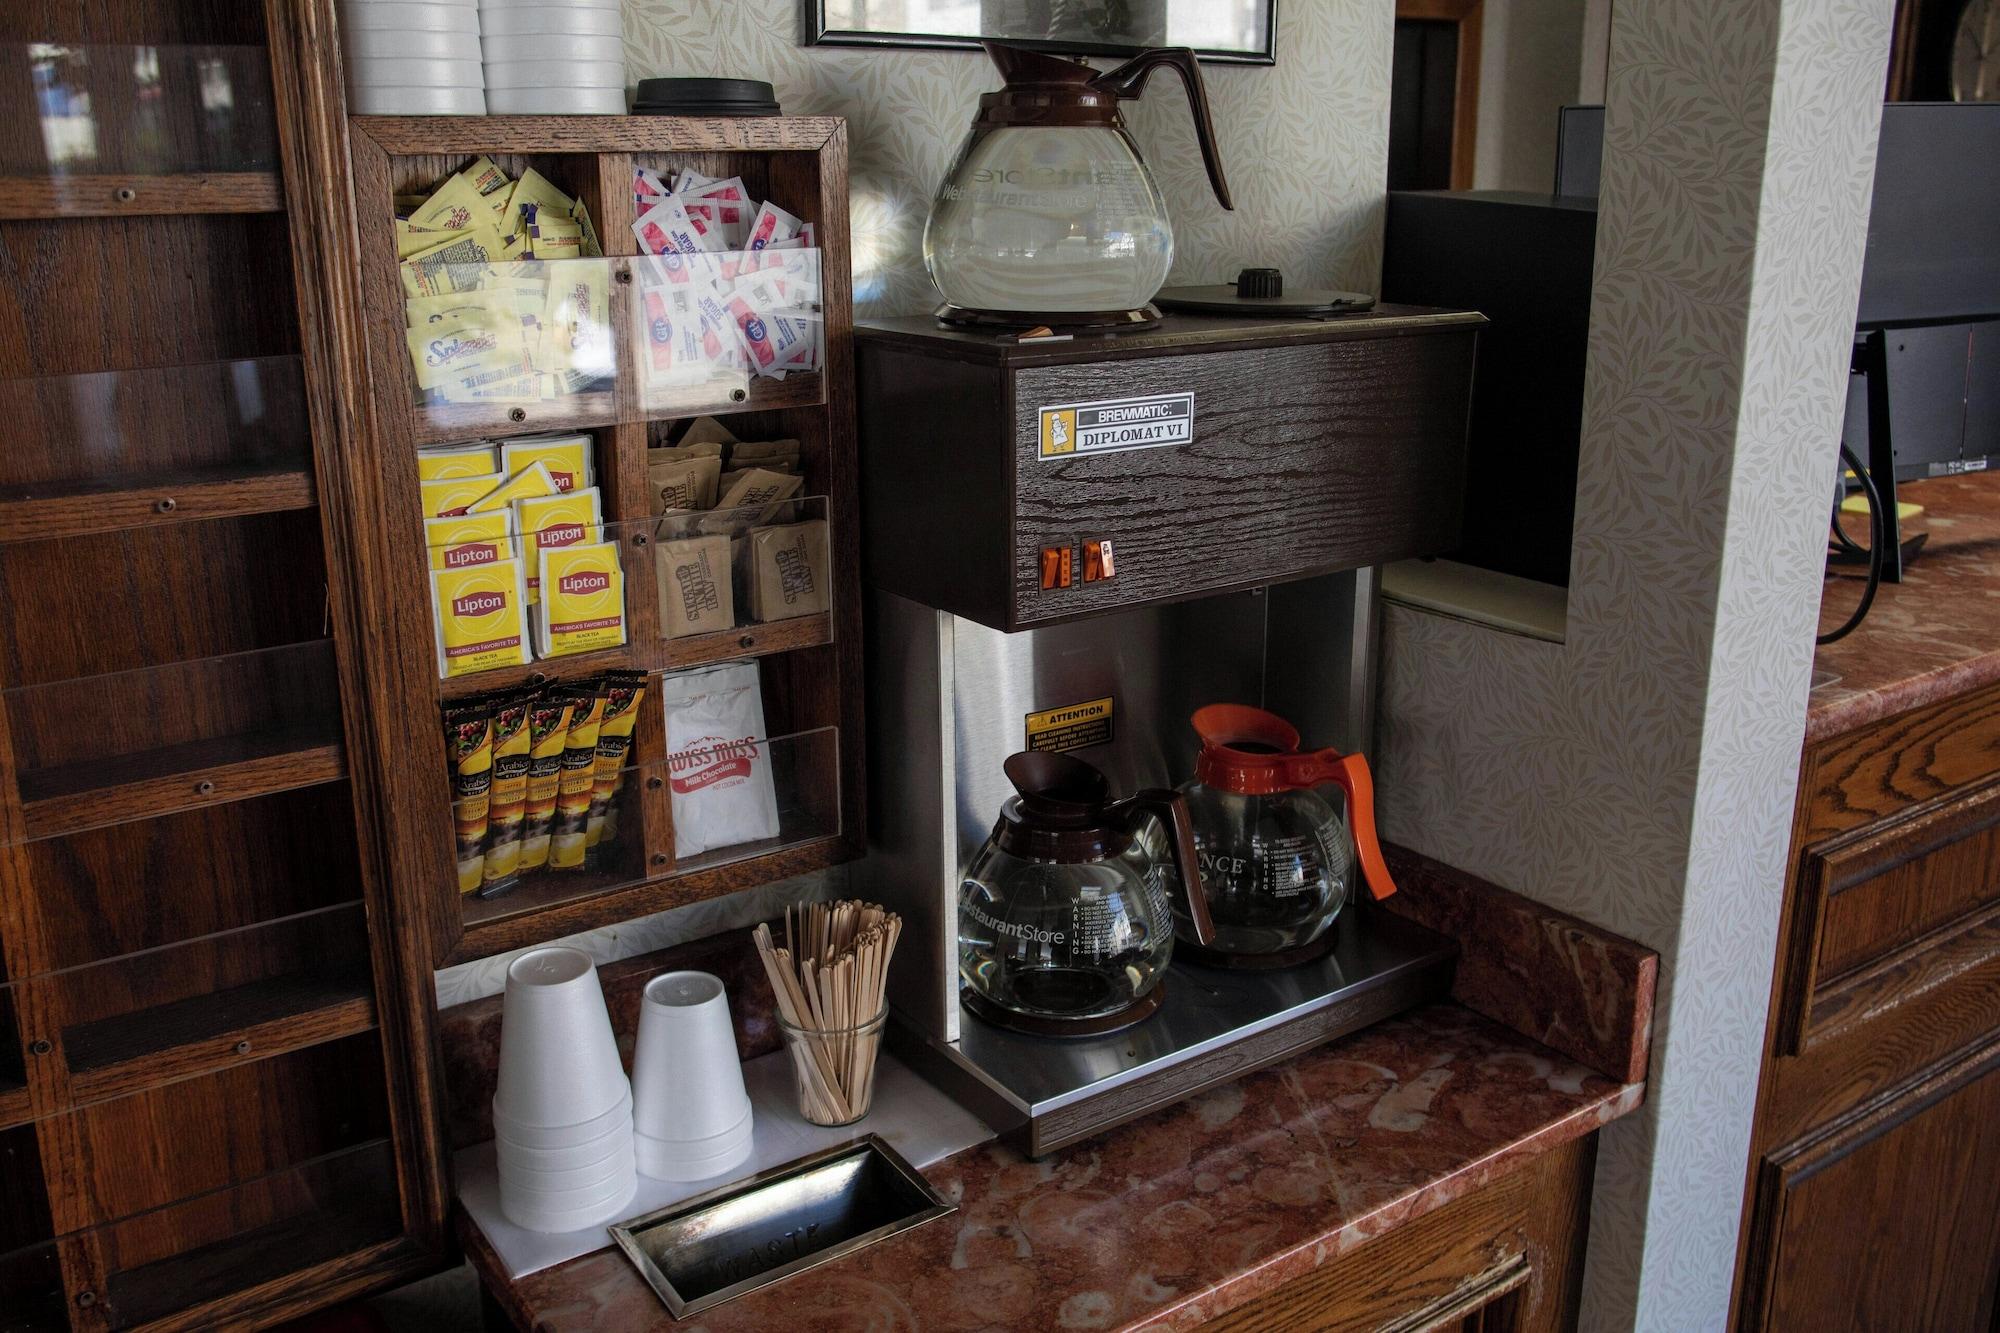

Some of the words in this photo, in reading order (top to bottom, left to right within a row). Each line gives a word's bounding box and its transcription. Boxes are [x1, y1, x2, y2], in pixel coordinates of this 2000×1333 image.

[1083, 425, 1164, 447] DIPLOMAT
[1166, 424, 1183, 437] VI
[540, 527, 582, 546] Lipton
[449, 549, 493, 565] Lipton
[563, 574, 606, 593] Lipton
[457, 594, 502, 614] Lipton
[554, 623, 584, 632] AMERICA'S
[584, 621, 609, 629] FAVORITE
[449, 645, 480, 655] AMERICA'S
[481, 640, 507, 650] FAVORITE
[1050, 705, 1103, 724] ATTENTION
[500, 760, 529, 771] Arabica
[534, 760, 561, 771] Arabica
[565, 753, 593, 762] Arabica
[668, 747, 712, 773] wiss
[462, 776, 490, 788] Arabica
[685, 774, 702, 788] Milk
[701, 762, 737, 781] Chocolate
[1071, 897, 1080, 955] WARNING
